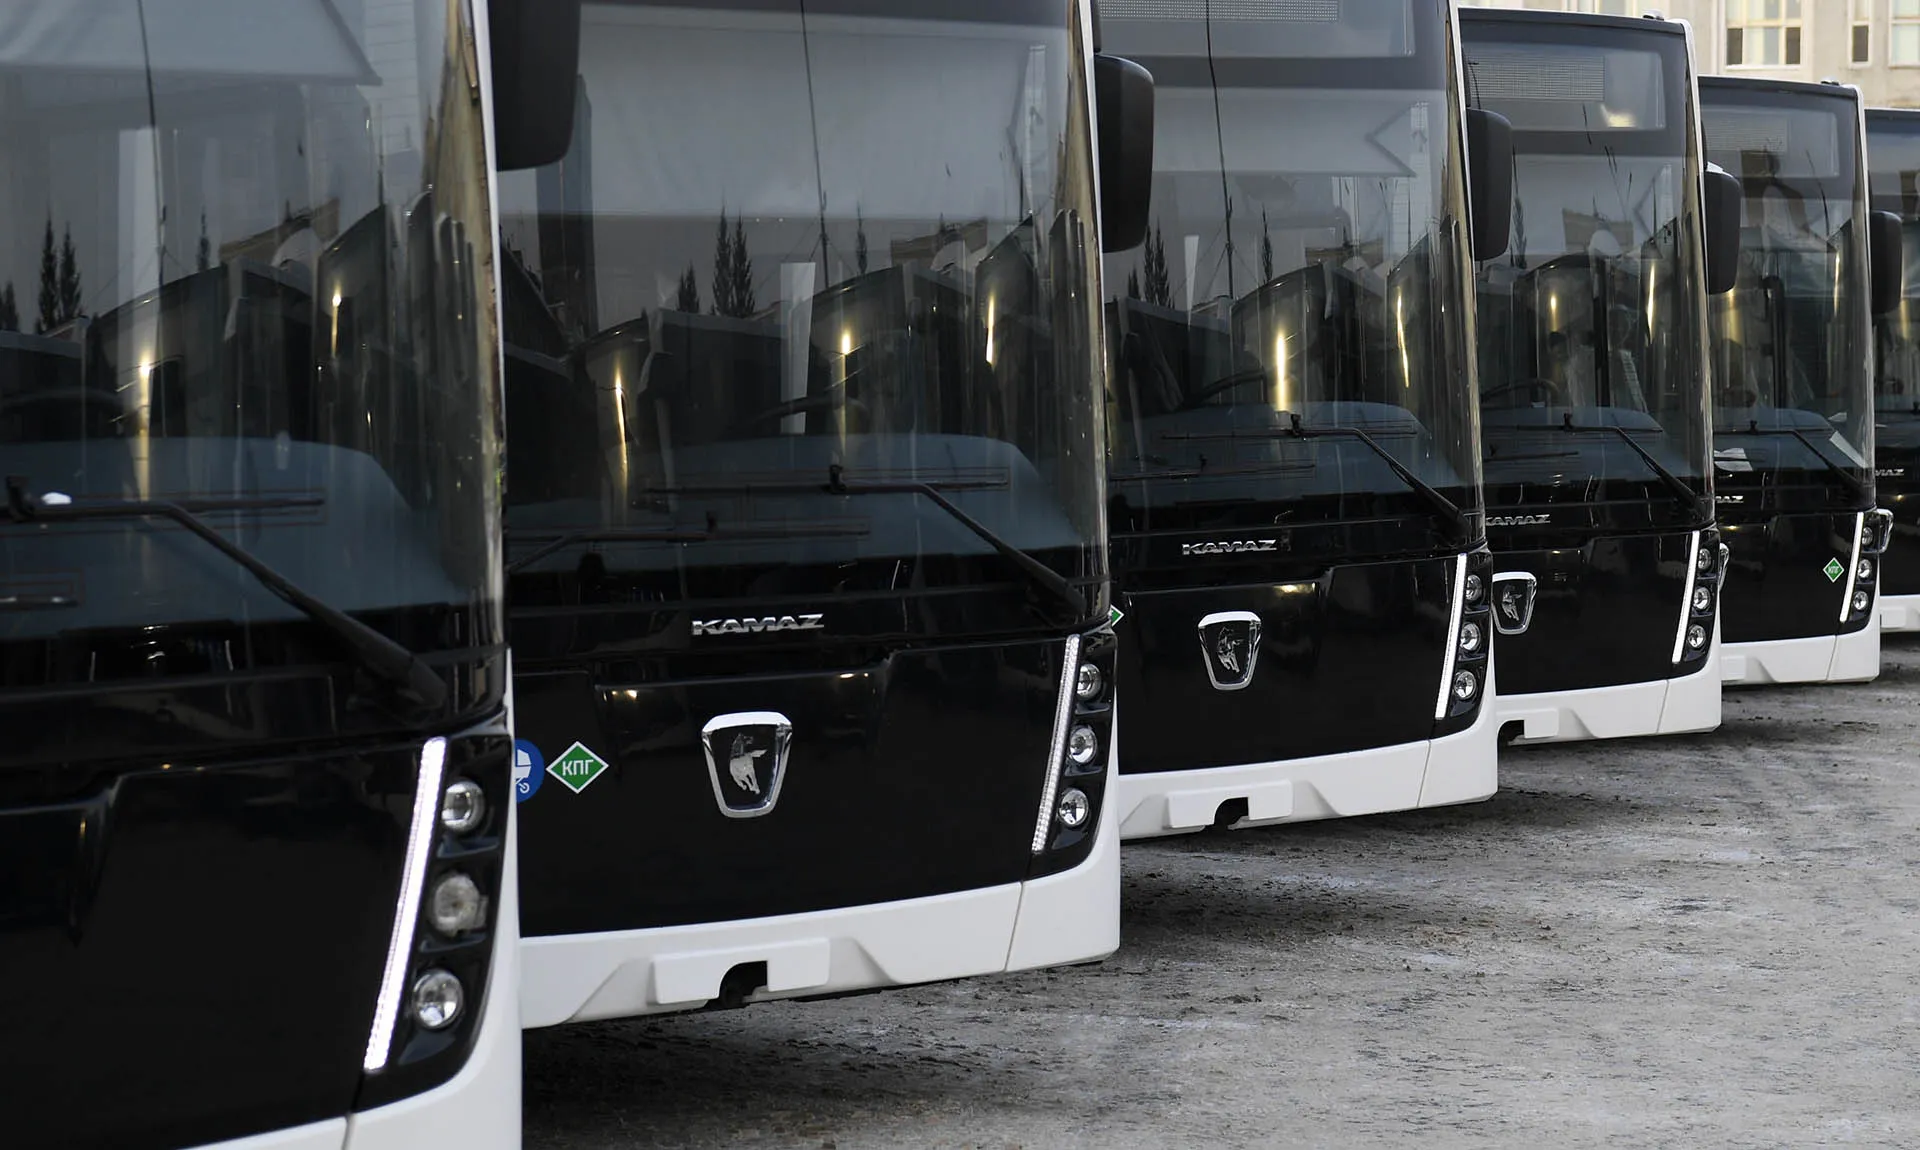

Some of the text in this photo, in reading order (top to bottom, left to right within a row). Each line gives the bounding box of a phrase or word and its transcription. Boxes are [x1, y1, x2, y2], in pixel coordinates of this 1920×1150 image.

[1182, 539, 1277, 555] KAMAZ
[692, 613, 824, 635] KAMAZ
[562, 759, 594, 776] КПГ
